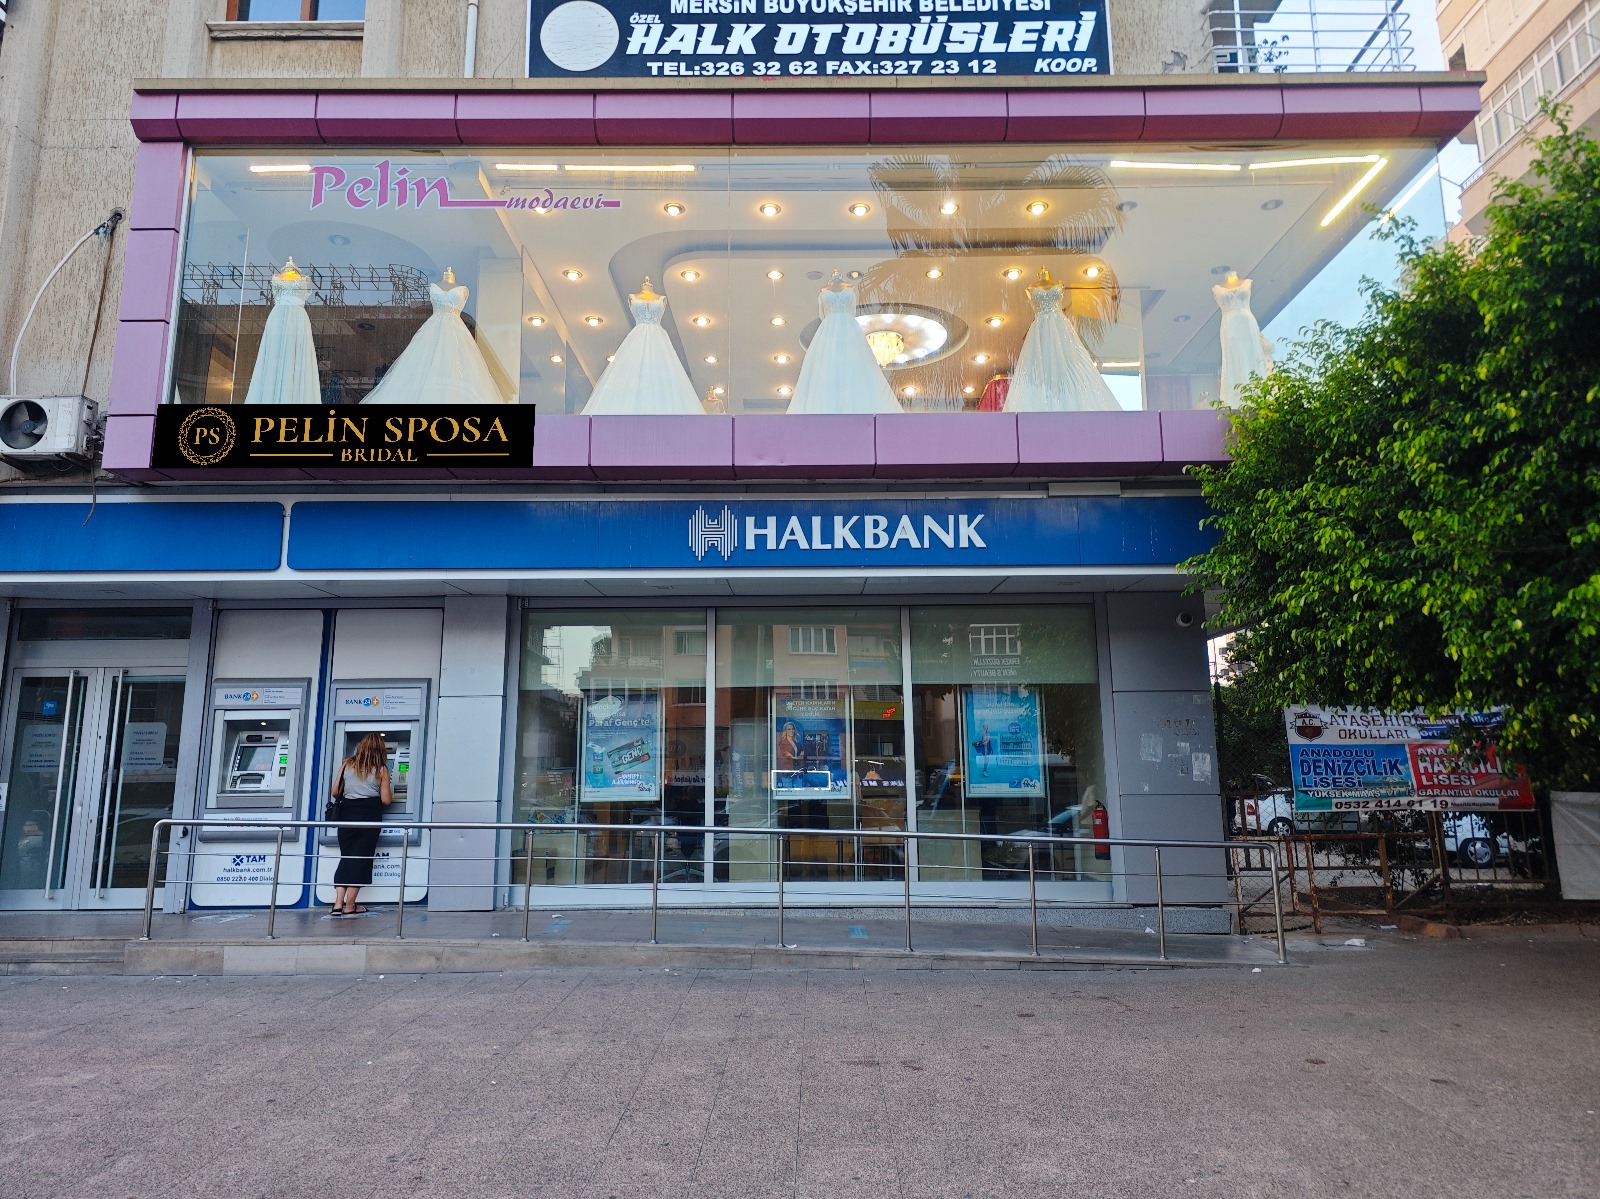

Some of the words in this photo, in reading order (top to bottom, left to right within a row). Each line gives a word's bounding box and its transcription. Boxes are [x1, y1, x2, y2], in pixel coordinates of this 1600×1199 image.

[629, 12, 661, 24] ÖZEL
[625, 23, 766, 55] HALK
[773, 11, 1097, 55] OTOBÜSLERİ
[647, 61, 745, 76] TEL:326
[752, 61, 781, 76] 32
[788, 61, 818, 75] 62
[826, 60, 922, 75] FAX:327
[931, 60, 960, 74] 23
[968, 60, 996, 74] 12
[1034, 58, 1098, 73] KOOP.
[310, 159, 450, 210] Pelin
[505, 188, 604, 210] modaevi
[250, 409, 370, 443] PELİN
[384, 416, 509, 443] SPOSA
[194, 427, 220, 445] PS
[340, 448, 419, 462] BRIDAL
[745, 514, 988, 550] HALKBANK
[1338, 729, 1411, 740] OKULLARI
[1299, 748, 1375, 758] ANADOLU
[1307, 788, 1348, 798] YÜKSEK
[1474, 788, 1520, 797] OKULLAR
[1334, 800, 1370, 810] 0532
[1374, 799, 1402, 809] 414
[1406, 799, 1424, 808] 61
[1430, 799, 1449, 809] 19
[245, 855, 266, 863] TAM
